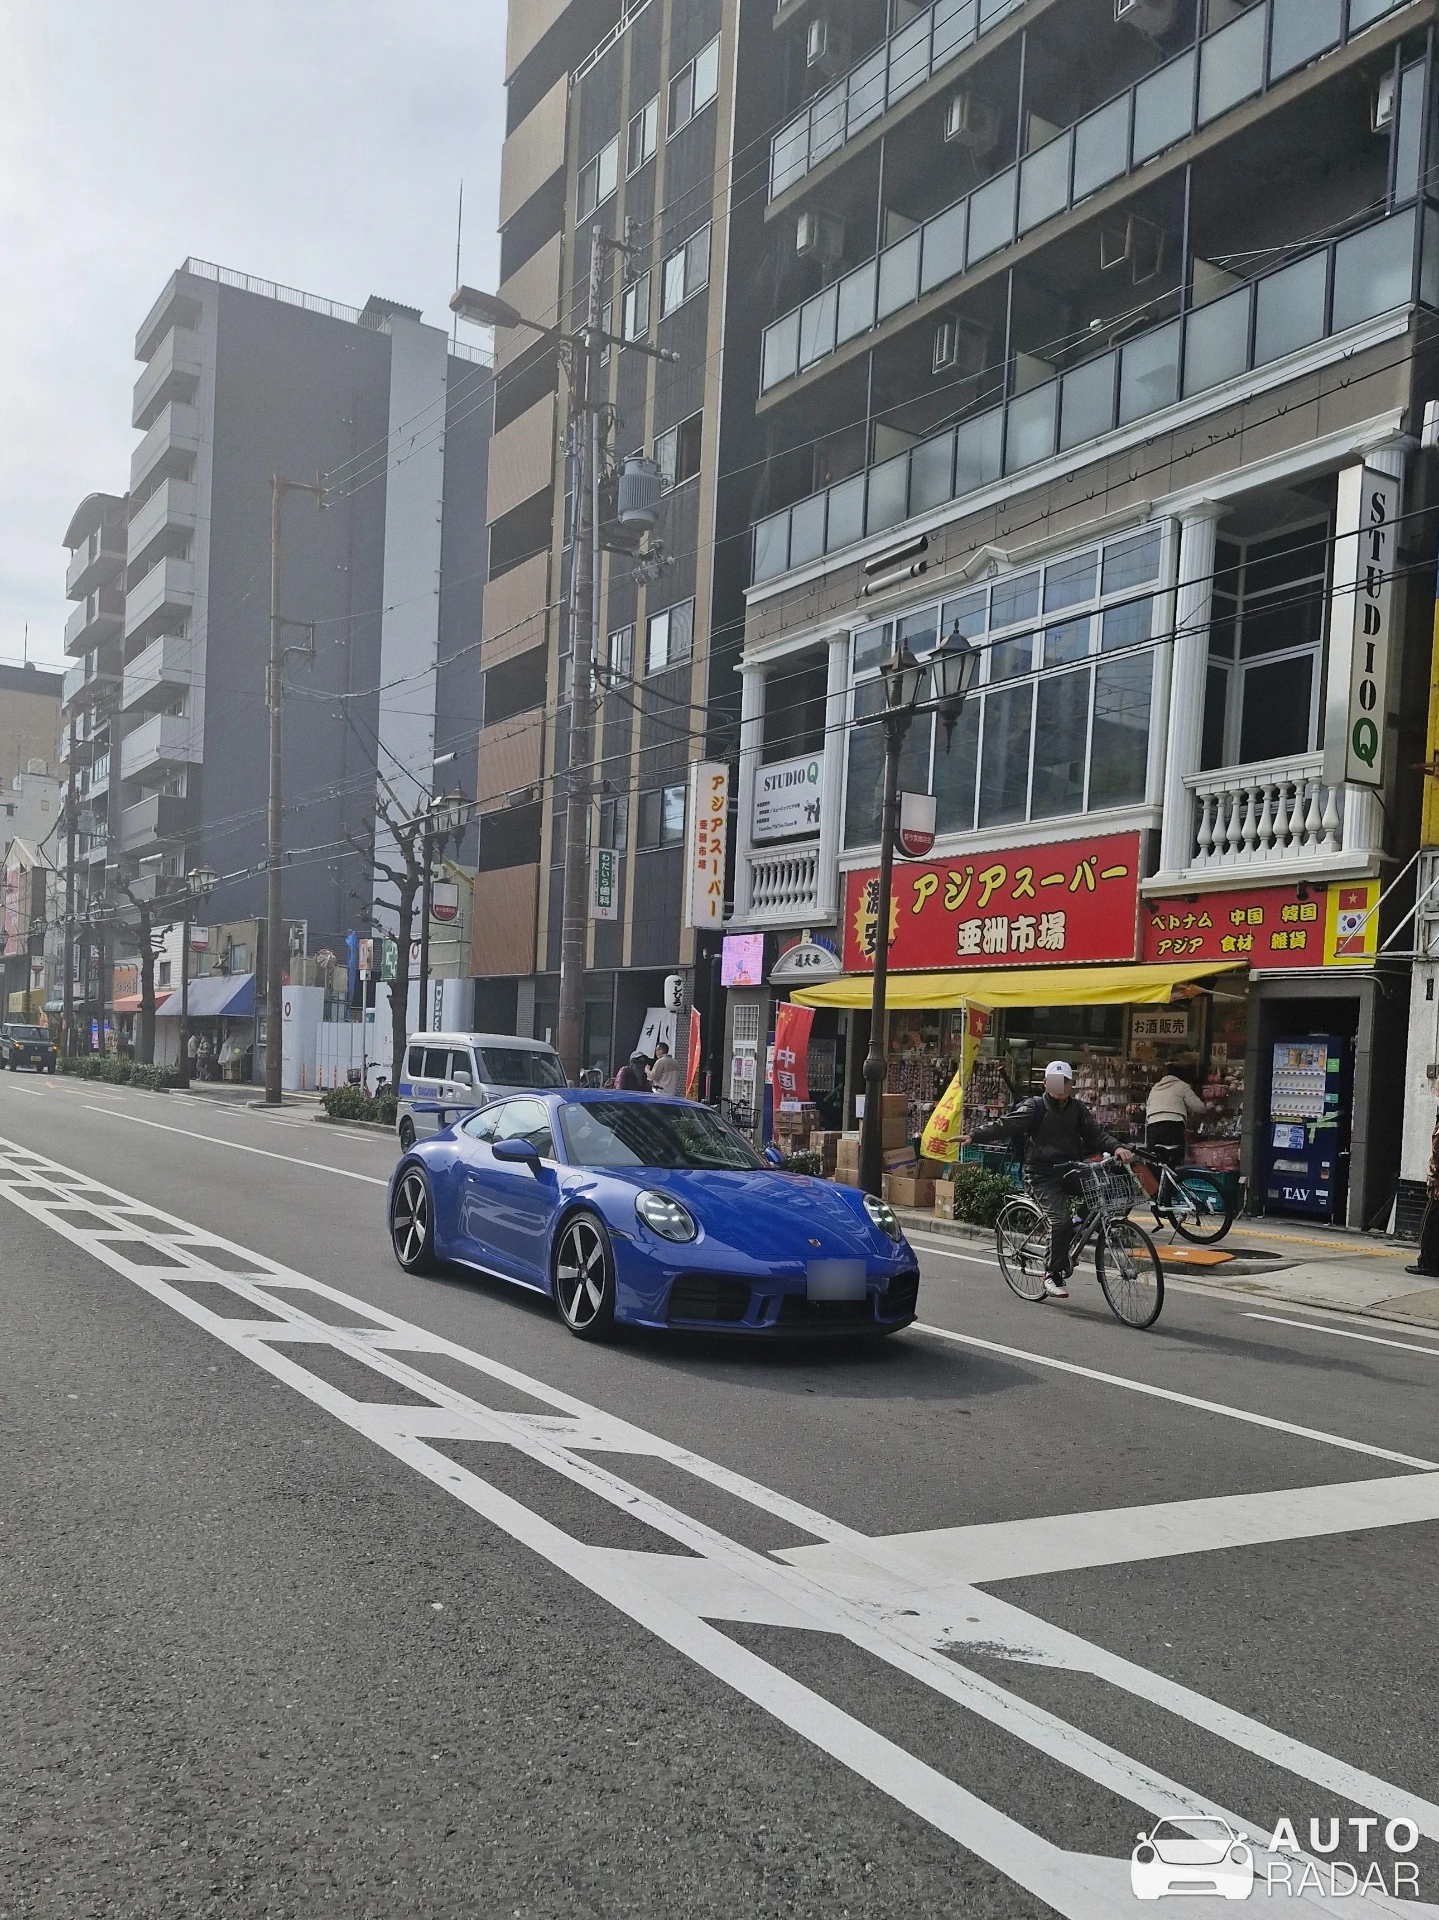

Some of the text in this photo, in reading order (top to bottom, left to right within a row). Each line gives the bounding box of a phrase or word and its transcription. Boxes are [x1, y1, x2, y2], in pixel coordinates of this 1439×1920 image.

[599, 853, 610, 906] わだいら歯科
[912, 856, 1128, 914] アジアスーパー
[957, 910, 1067, 956] 亜洲市場
[1151, 902, 1317, 932] ベトナム 中国 韓国
[1157, 930, 1307, 955] アジア 食材 雑貨
[1133, 1019, 1185, 1034] お酒販売
